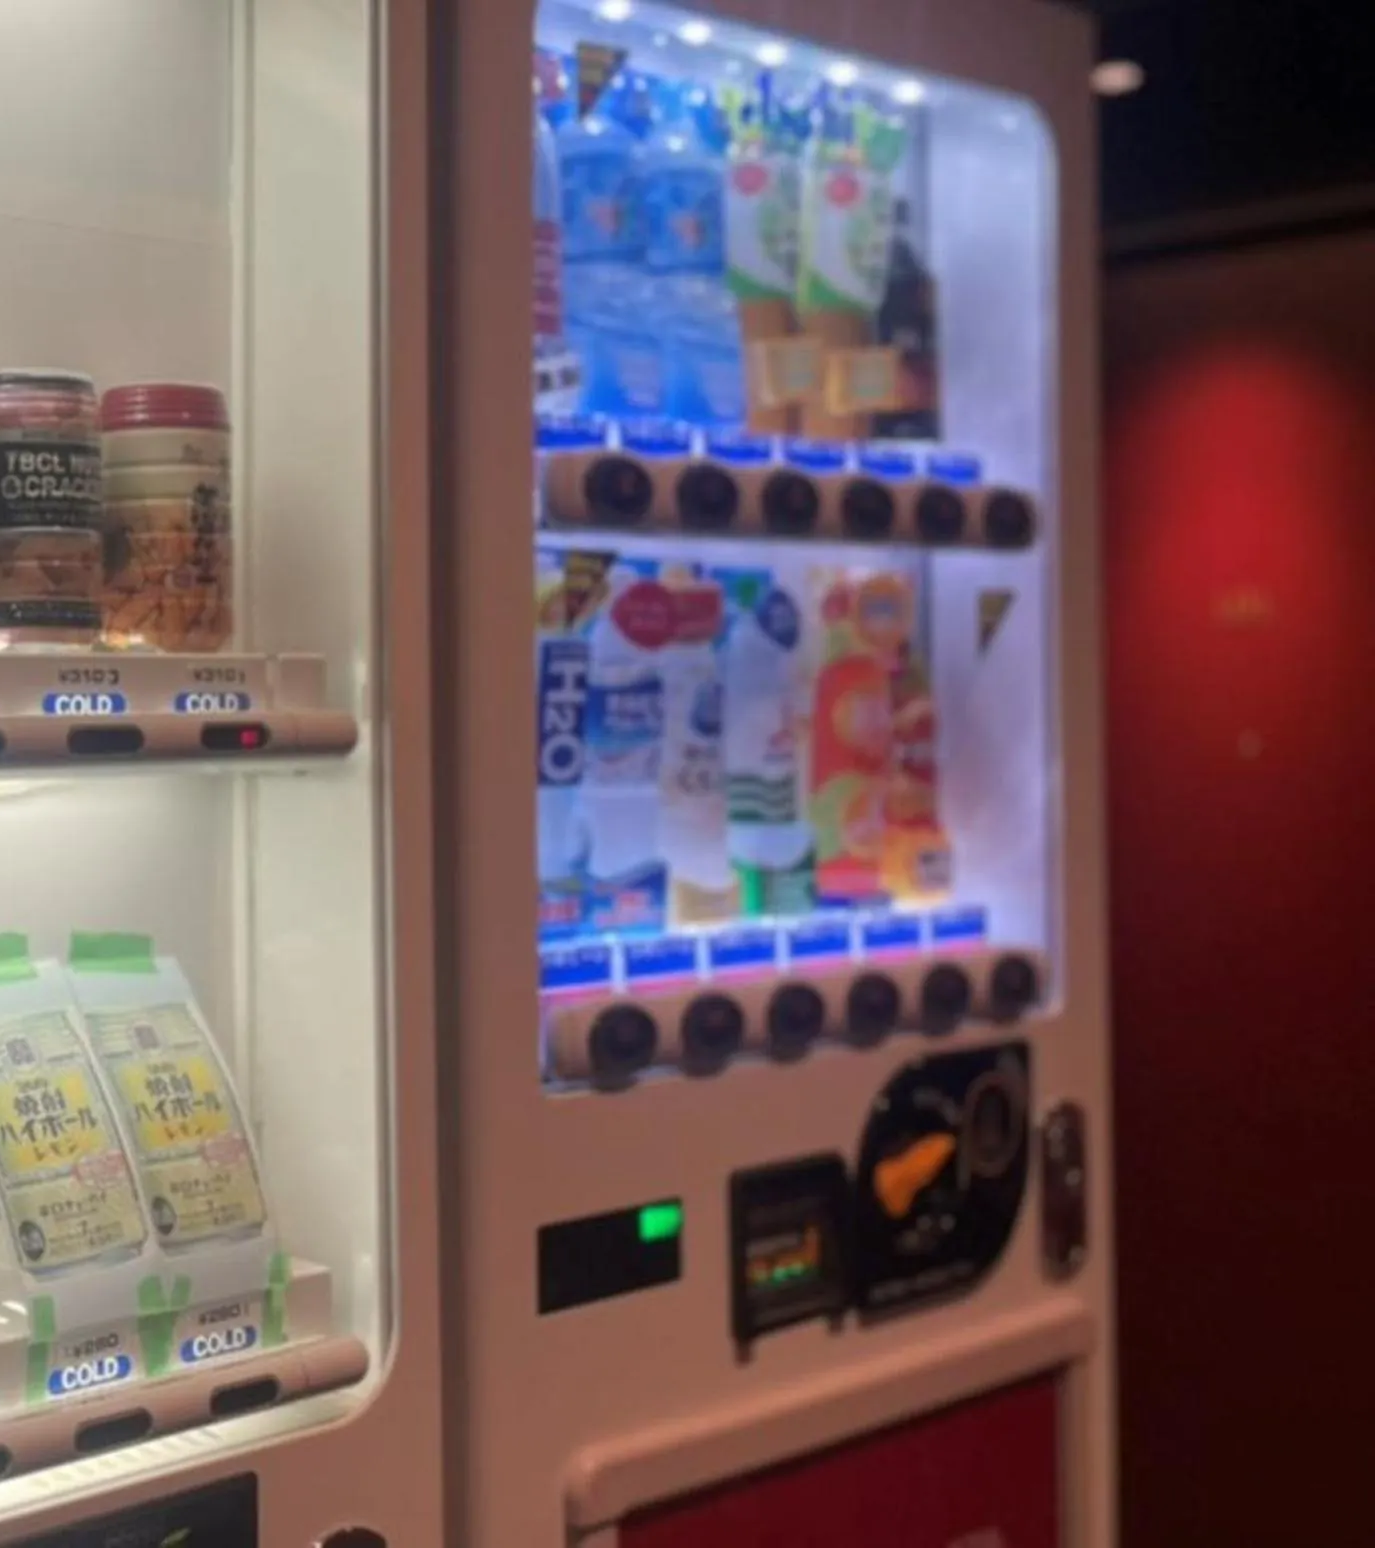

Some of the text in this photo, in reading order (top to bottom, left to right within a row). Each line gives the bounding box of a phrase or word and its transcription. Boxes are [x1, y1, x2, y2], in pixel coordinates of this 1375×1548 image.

[4, 450, 65, 474] TBCL
[54, 694, 113, 717] COLD
[184, 693, 239, 714] COLD
[542, 660, 586, 782] H2O
[192, 1326, 247, 1360] COLD
[61, 1356, 120, 1390] COLD
